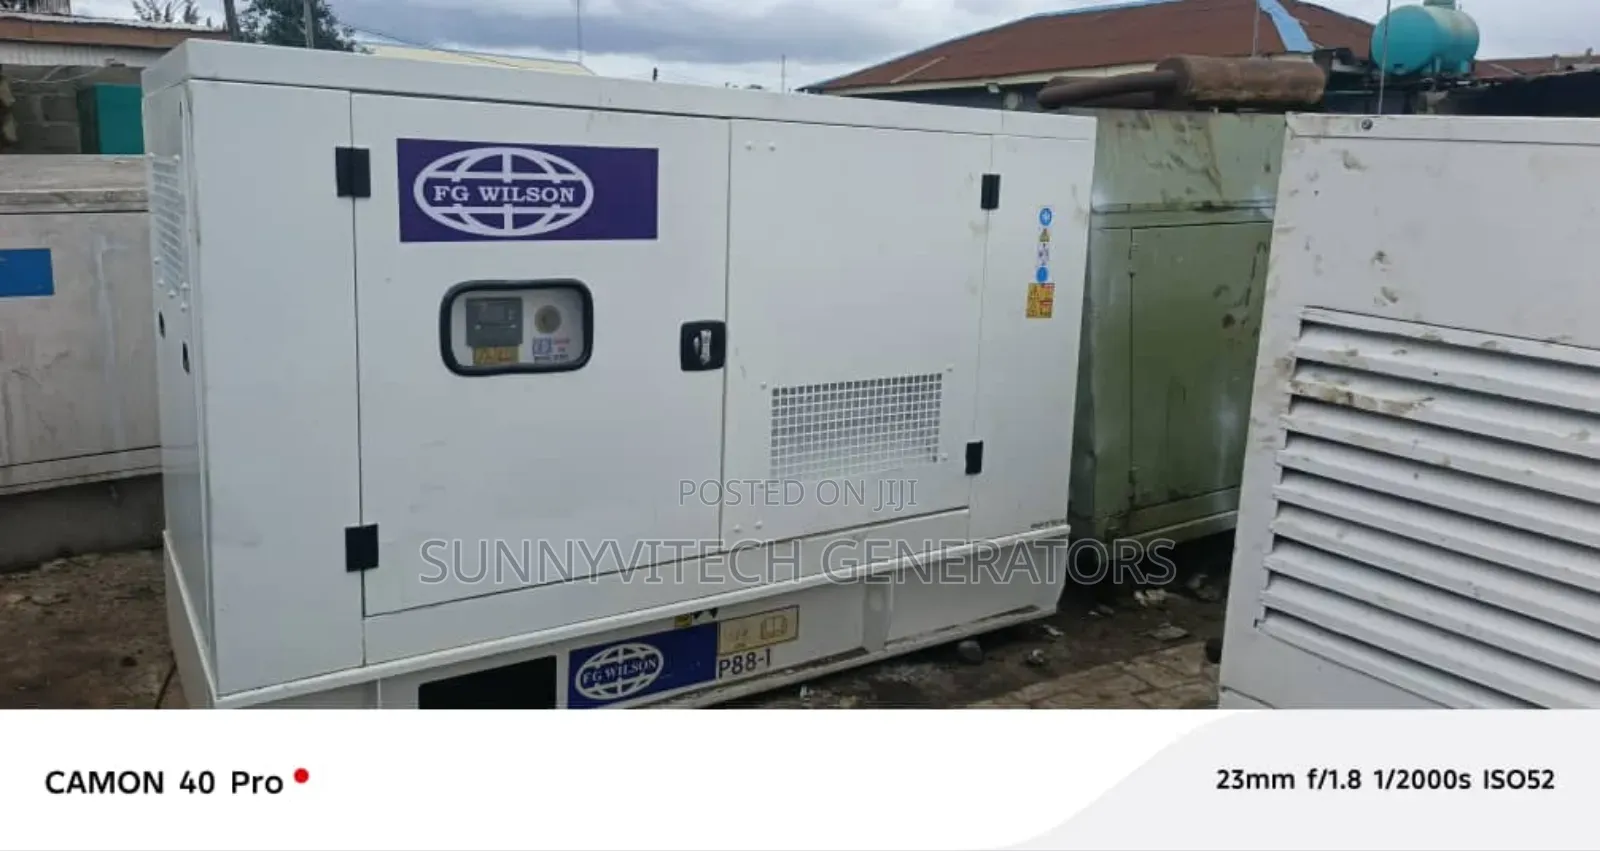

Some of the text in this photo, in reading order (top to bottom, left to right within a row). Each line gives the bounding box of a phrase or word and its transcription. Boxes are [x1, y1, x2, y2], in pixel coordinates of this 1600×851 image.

[433, 185, 575, 203] FG WILSON
[582, 658, 657, 685] FG WILSON
